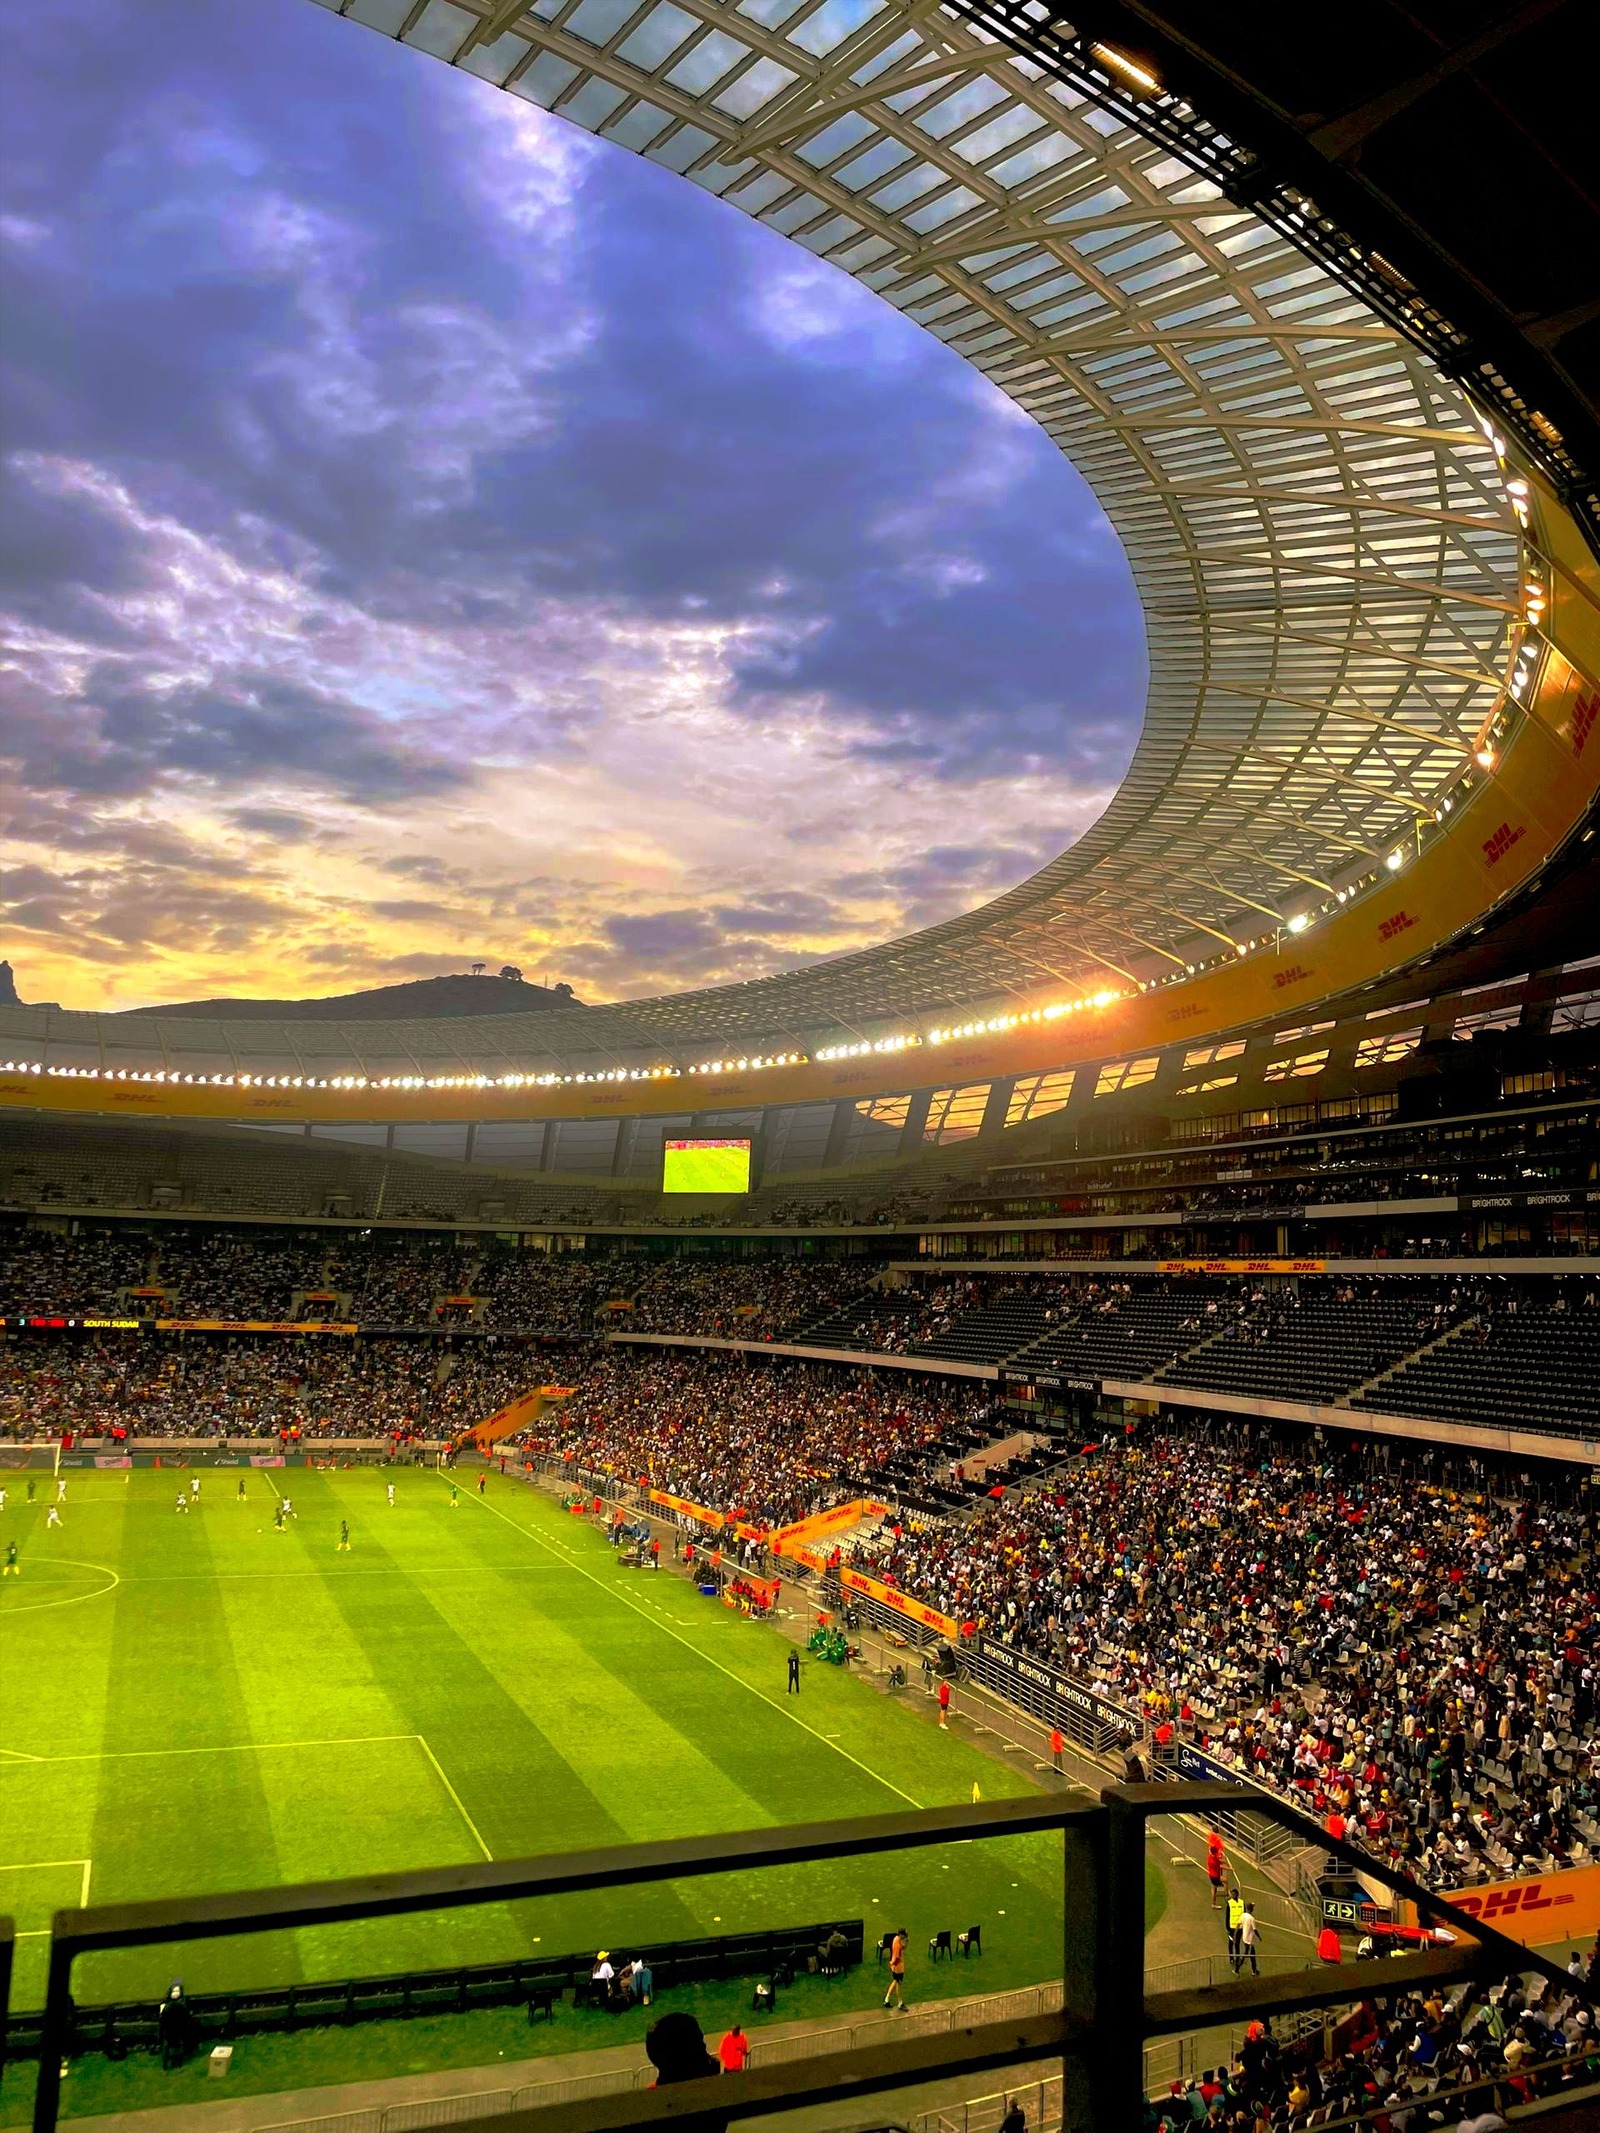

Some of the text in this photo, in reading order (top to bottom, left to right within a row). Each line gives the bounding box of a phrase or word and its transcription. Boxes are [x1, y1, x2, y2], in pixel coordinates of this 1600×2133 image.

[1572, 692, 1599, 754] DHL
[1482, 822, 1521, 865] DHL
[1377, 911, 1415, 940] DHL
[1273, 965, 1309, 988] DHL
[1205, 1263, 1227, 1271] DHL
[1248, 1263, 1270, 1271] DHL
[1292, 1263, 1317, 1271] DHL
[83, 1320, 111, 1328] SOUTH
[112, 1320, 139, 1328] SUDAN
[869, 1503, 886, 1515] DHL
[779, 1509, 852, 1539] DHL DHL
[801, 1552, 817, 1566] DHL
[852, 1575, 944, 1627] DHL DHL DHL
